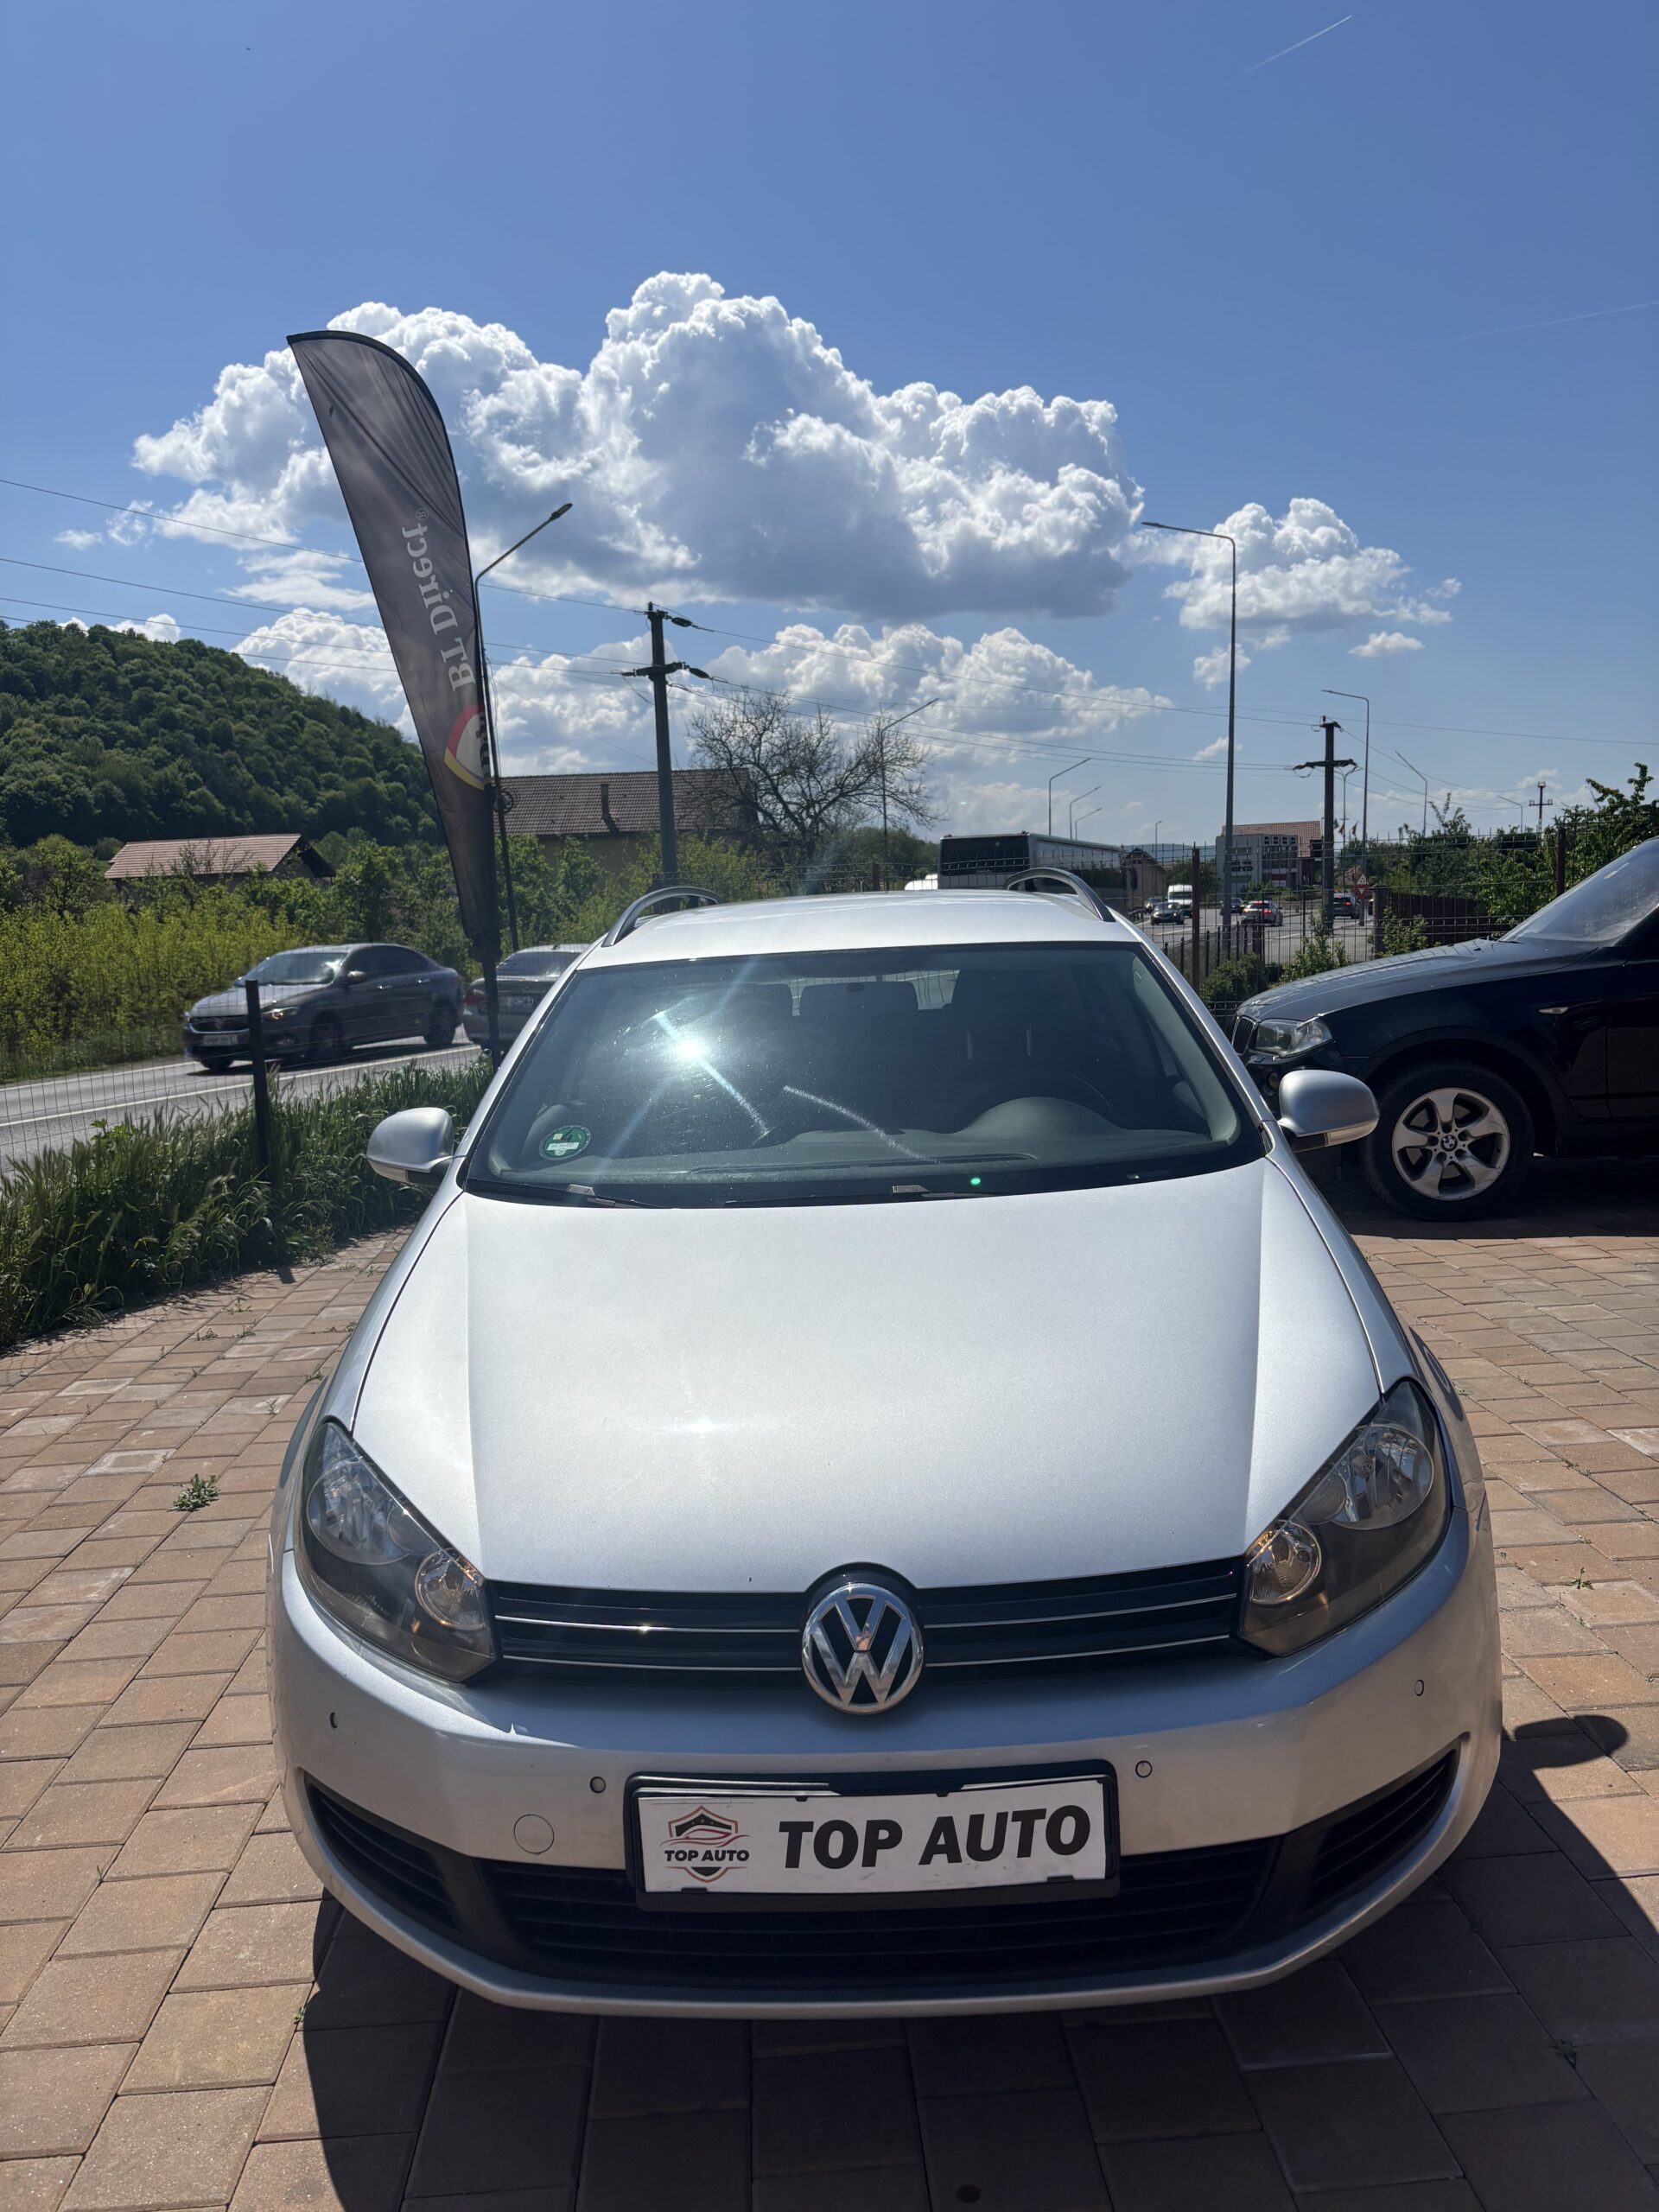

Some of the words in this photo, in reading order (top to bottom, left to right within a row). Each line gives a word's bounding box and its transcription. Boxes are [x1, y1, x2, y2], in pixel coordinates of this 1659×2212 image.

[807, 1596, 913, 1708] VW
[664, 1849, 698, 1861] TOP
[701, 1849, 750, 1861] AUTO
[778, 1819, 903, 1870] TOP
[918, 1804, 1090, 1866] AUTO
